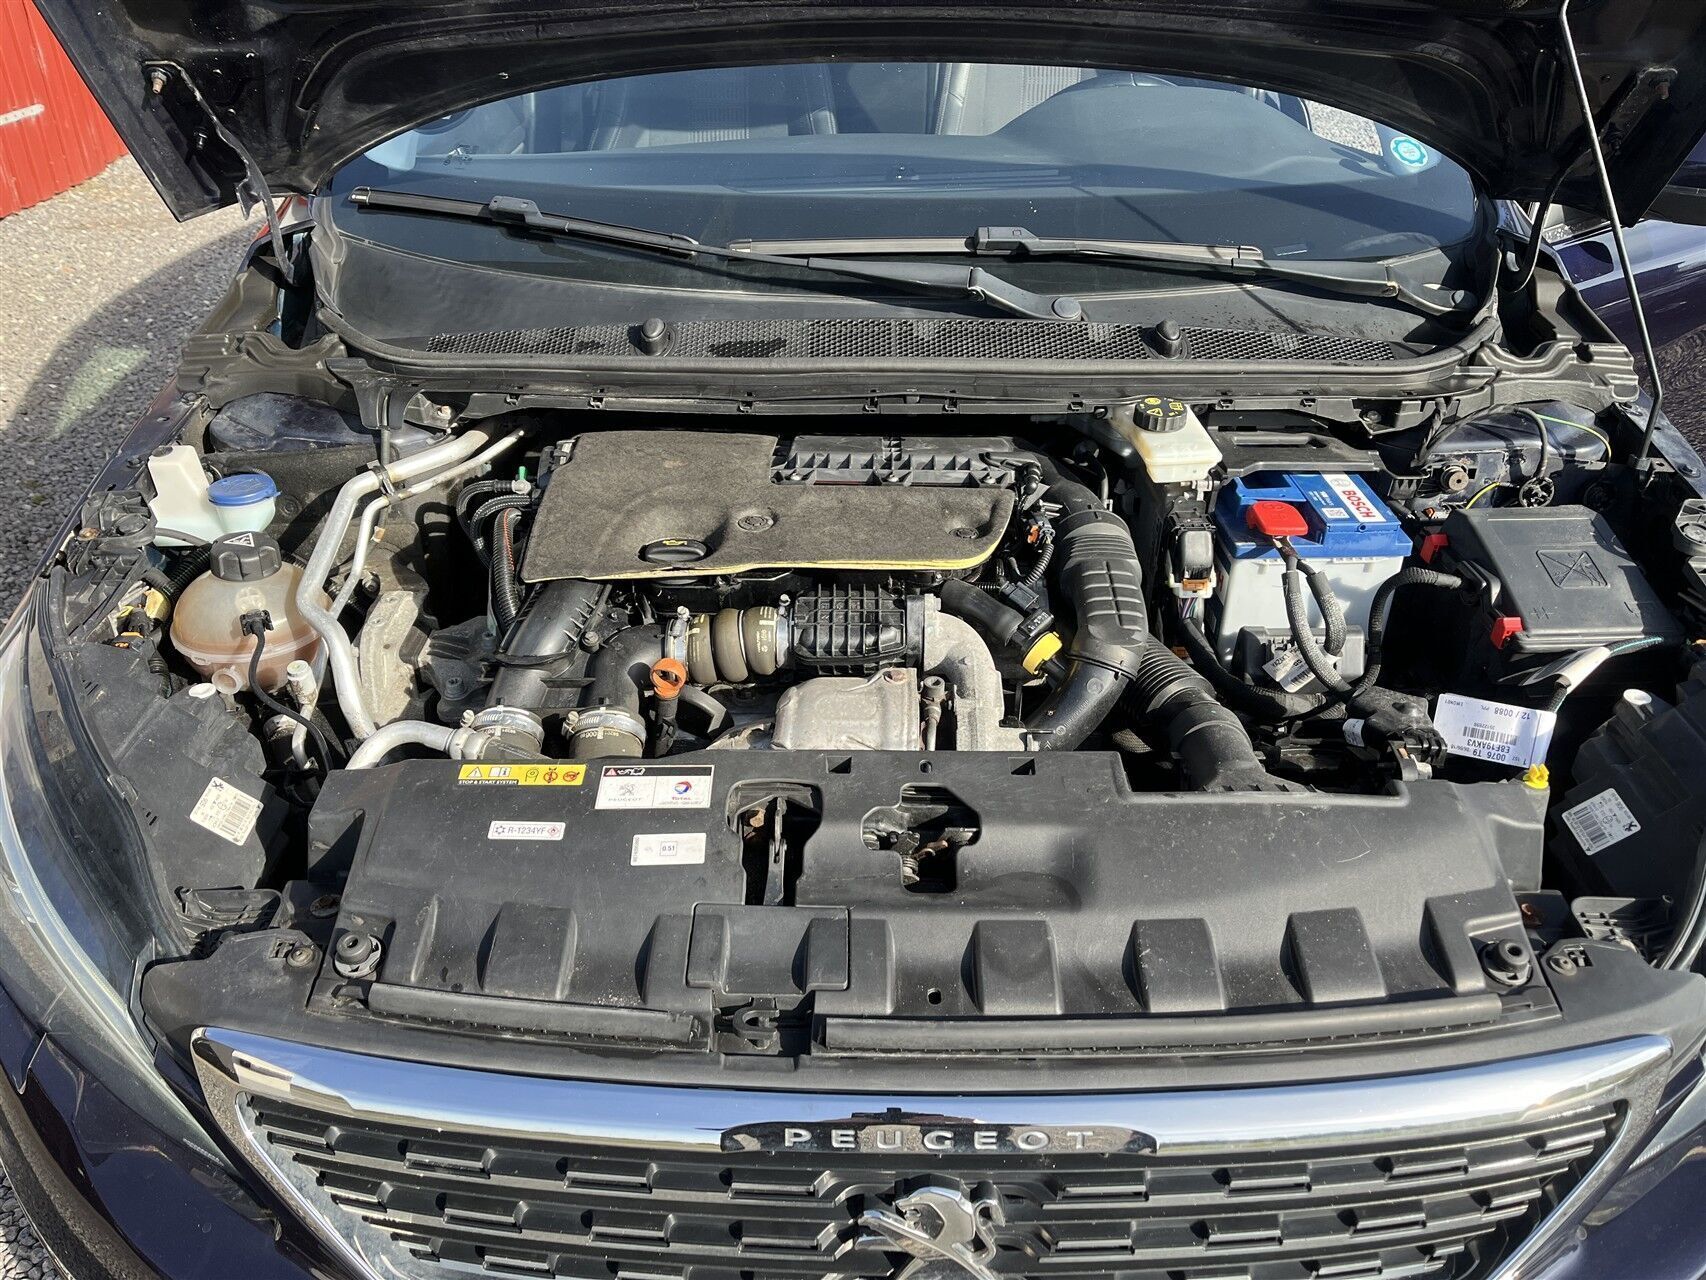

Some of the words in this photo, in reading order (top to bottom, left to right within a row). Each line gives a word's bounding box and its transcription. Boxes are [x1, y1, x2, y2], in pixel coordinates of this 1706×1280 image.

[1341, 489, 1376, 519] BOSCH
[1494, 707, 1513, 717] 0088
[1521, 711, 1531, 720] 12
[1467, 738, 1511, 753] E8F19AKV3
[1472, 748, 1482, 757] T9
[1486, 751, 1506, 761] 0076
[507, 826, 546, 835] R-1234YF
[784, 1127, 1094, 1150] PEUGEOT
